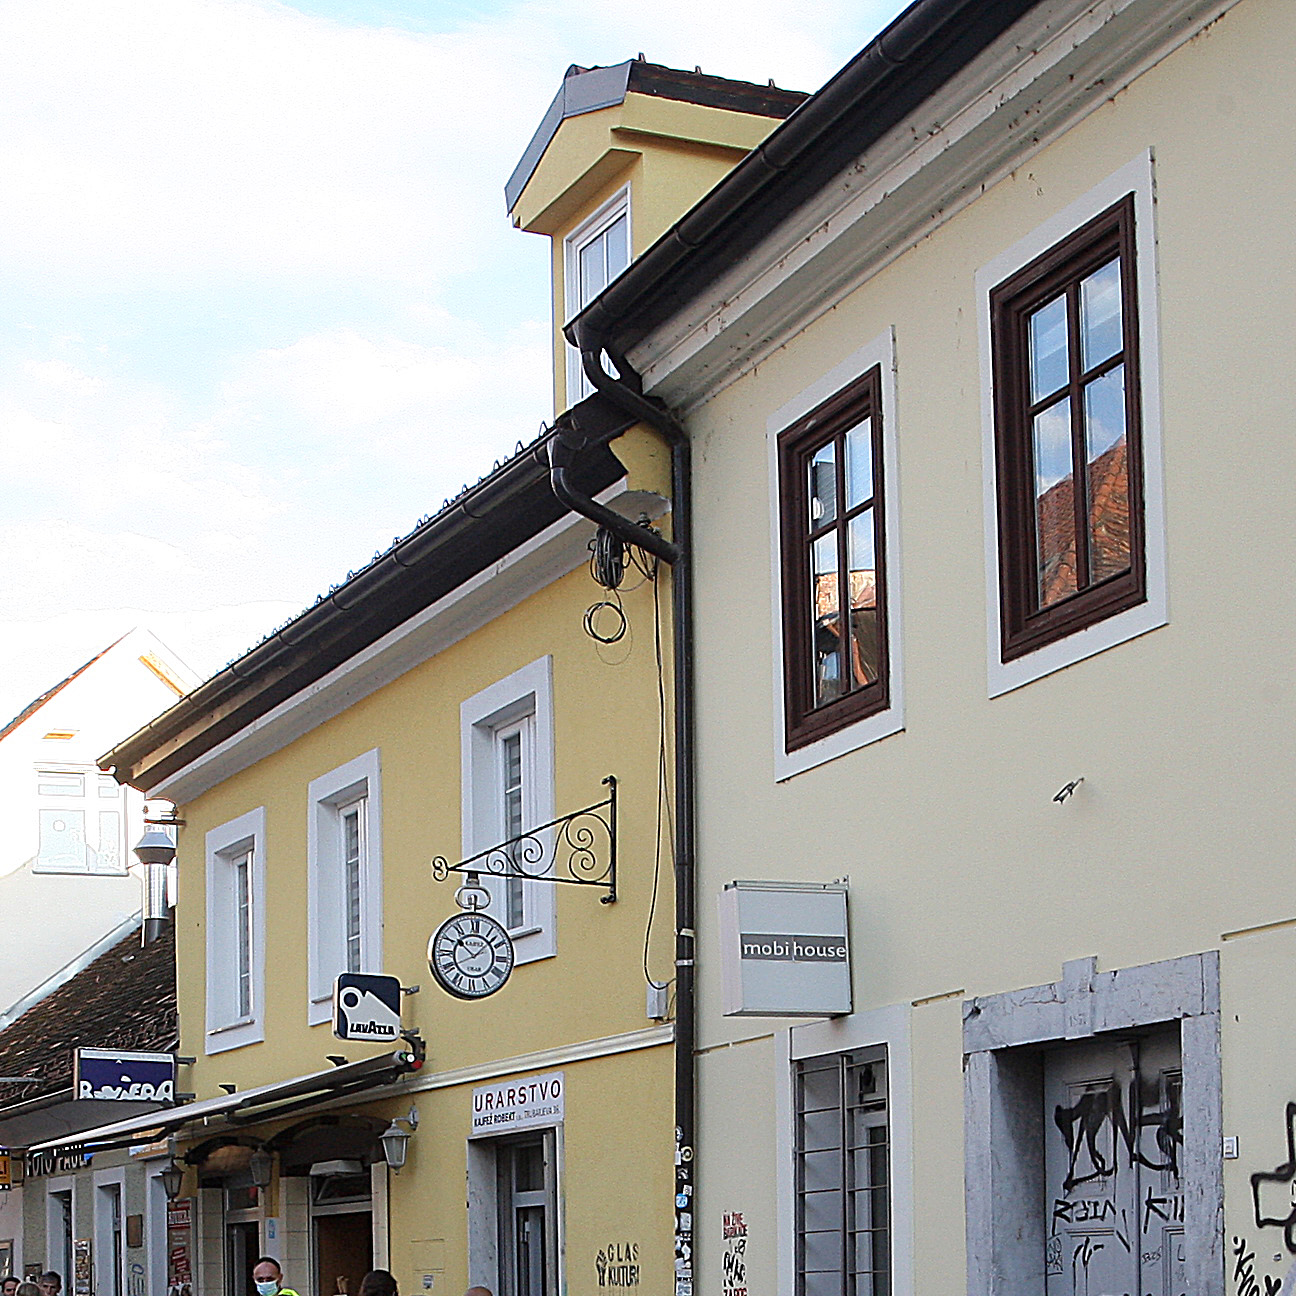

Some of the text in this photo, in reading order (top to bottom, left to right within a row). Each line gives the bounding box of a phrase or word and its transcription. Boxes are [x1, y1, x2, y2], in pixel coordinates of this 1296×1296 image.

[744, 941, 846, 957] mobi house
[350, 1020, 395, 1035] LAVAZZA
[474, 1080, 561, 1112] URARSTVO
[607, 1242, 640, 1262] GLAS
